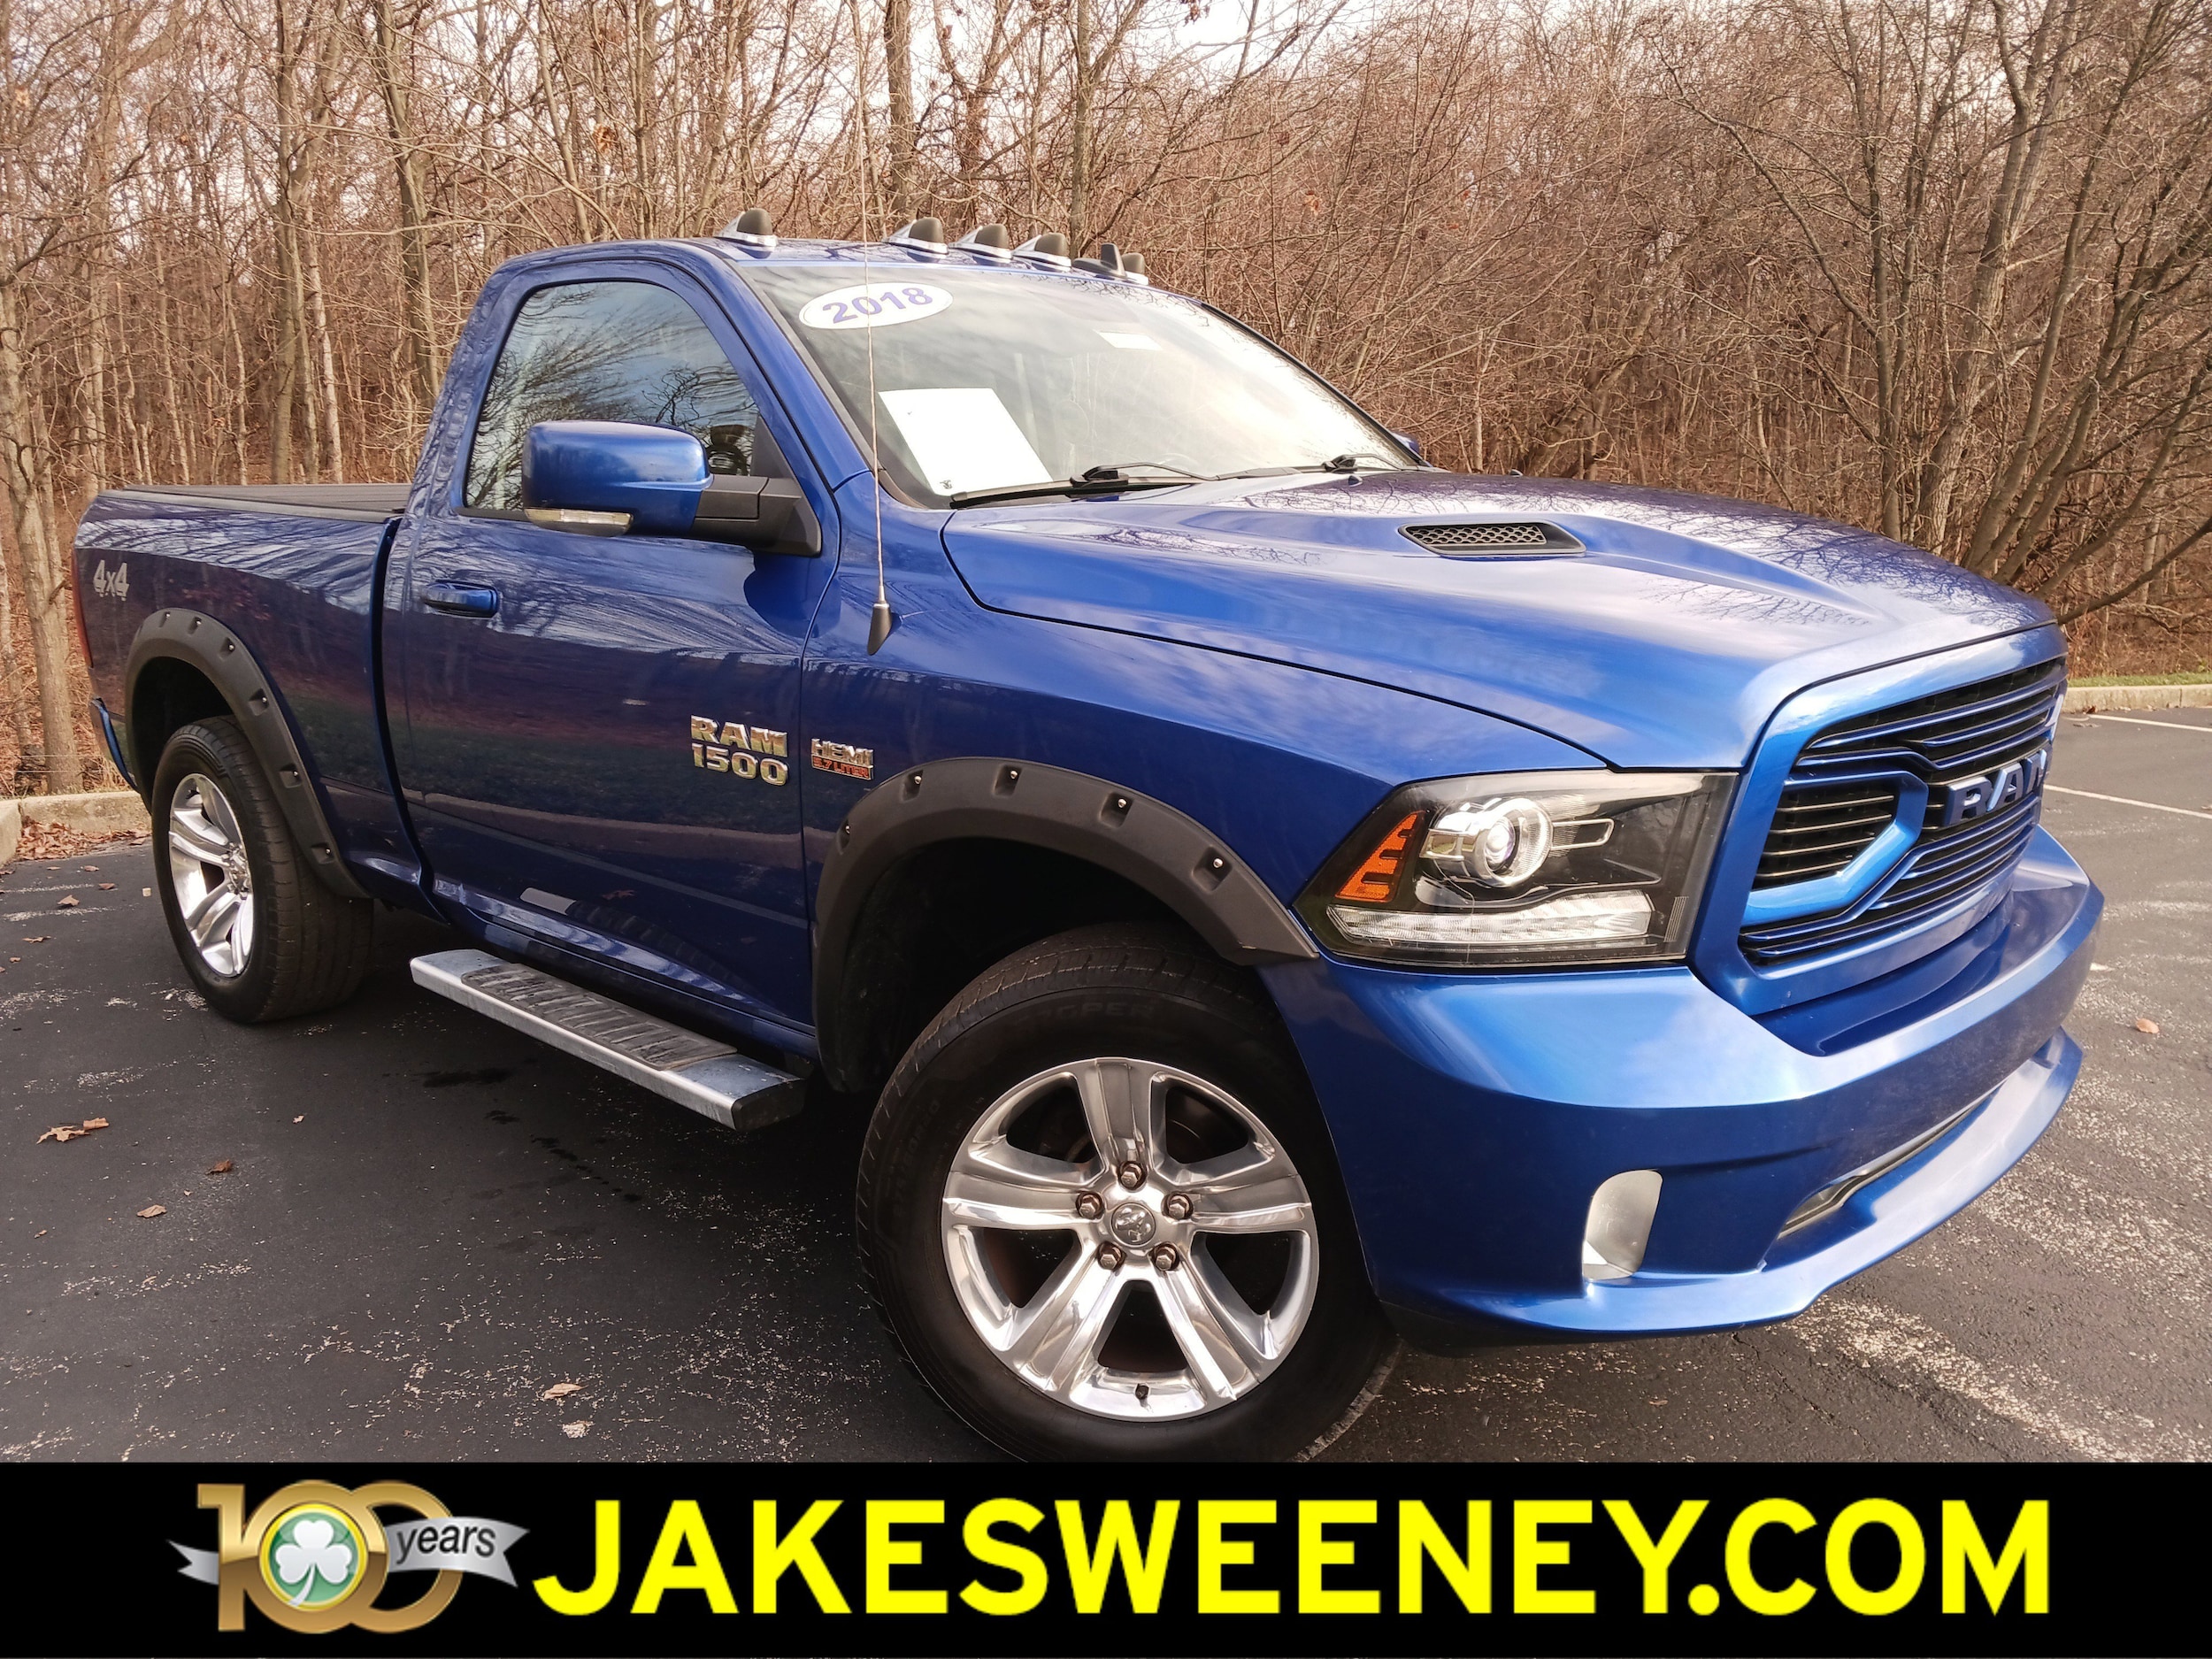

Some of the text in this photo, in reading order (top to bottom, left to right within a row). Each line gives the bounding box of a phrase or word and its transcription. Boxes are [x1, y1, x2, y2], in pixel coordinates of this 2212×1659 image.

[822, 287, 933, 324] 2018
[690, 714, 788, 757] RAM
[811, 738, 874, 768] HEMI
[692, 742, 789, 787] 1500
